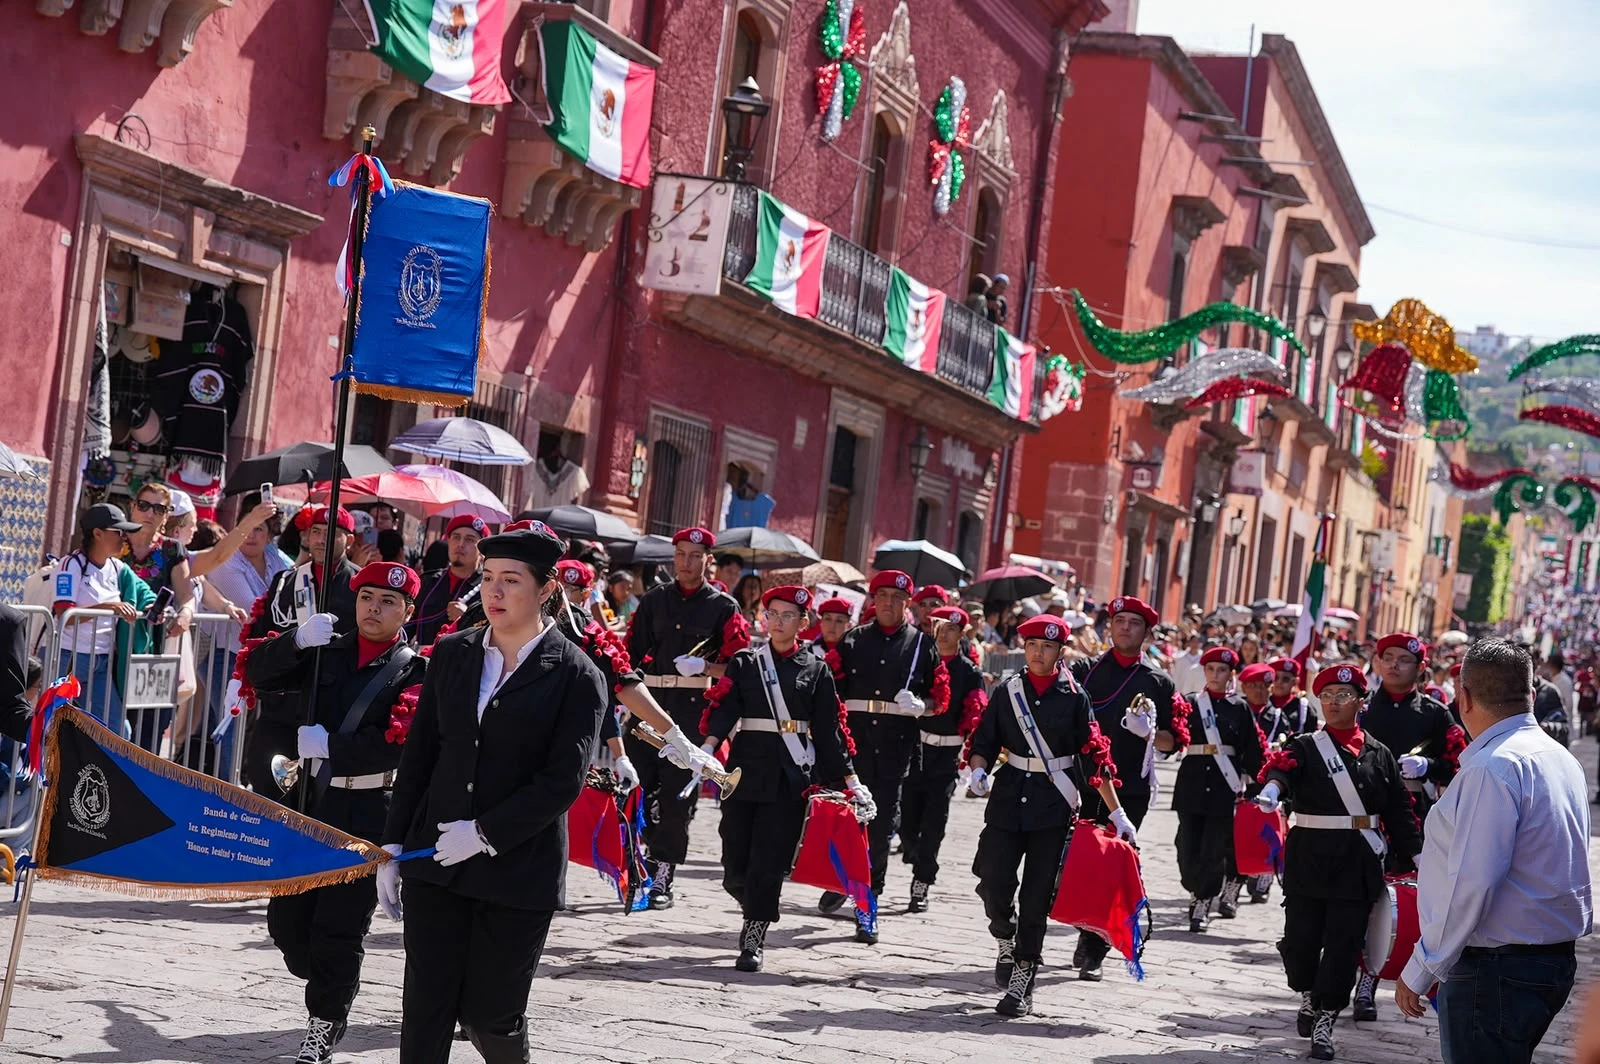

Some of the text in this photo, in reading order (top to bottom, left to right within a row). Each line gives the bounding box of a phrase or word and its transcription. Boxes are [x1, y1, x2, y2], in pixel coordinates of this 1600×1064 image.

[688, 208, 711, 241] 2
[659, 246, 681, 278] 3
[203, 806, 228, 819] Banda
[229, 811, 238, 821] de
[200, 825, 239, 841] Regimiento
[239, 832, 270, 848] Provincial
[230, 852, 236, 862] y
